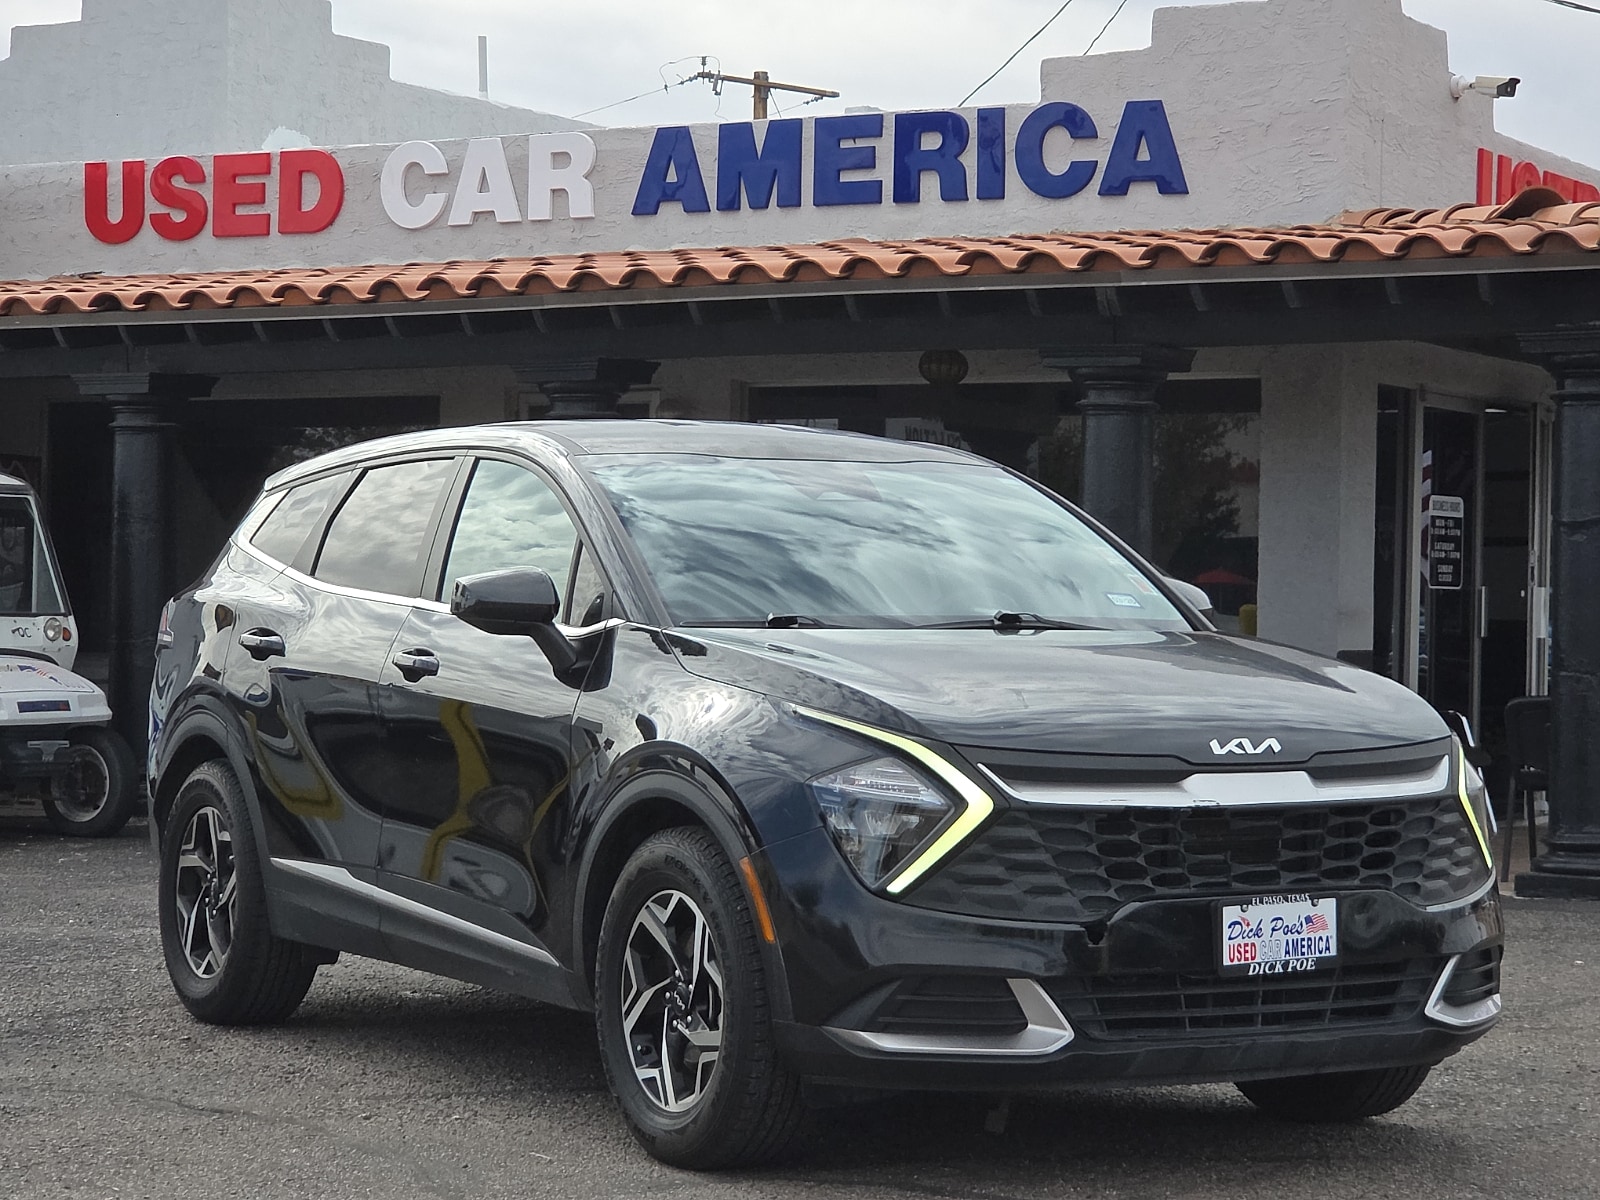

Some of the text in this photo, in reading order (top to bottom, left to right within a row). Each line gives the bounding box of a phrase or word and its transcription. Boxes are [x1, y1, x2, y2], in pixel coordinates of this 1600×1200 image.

[84, 99, 1190, 244] USED CAR AMERICA
[1209, 737, 1281, 754] KIA
[1251, 897, 1260, 906] EL
[1287, 893, 1310, 903] TEXAS
[1227, 914, 1304, 941] Dick Poe's
[1228, 935, 1331, 963] USED CAR AMERICA
[1247, 957, 1317, 976] DICK POE
